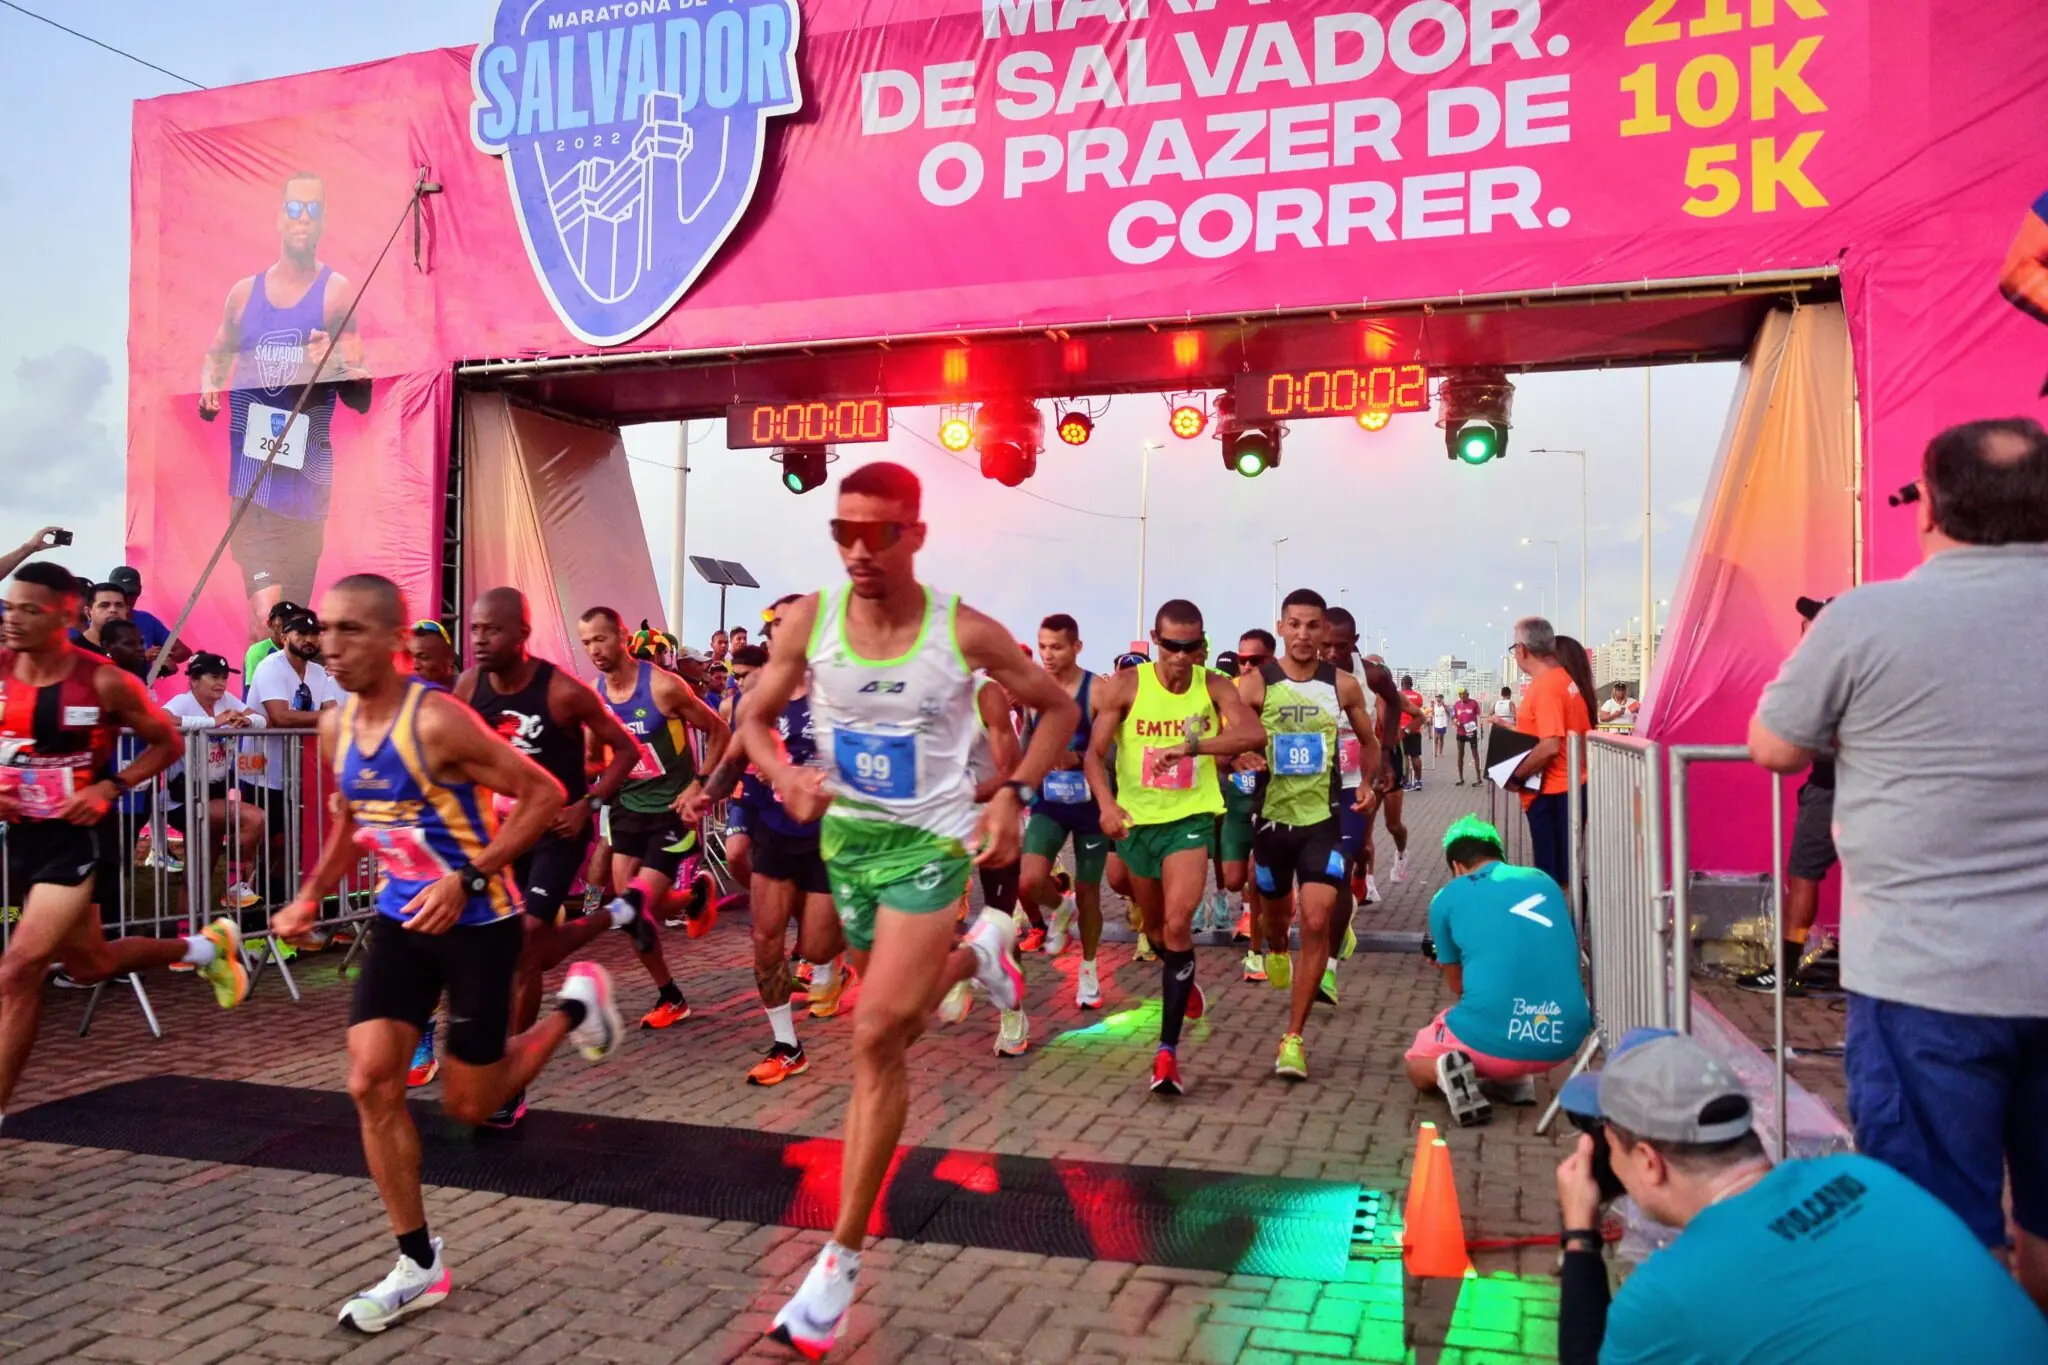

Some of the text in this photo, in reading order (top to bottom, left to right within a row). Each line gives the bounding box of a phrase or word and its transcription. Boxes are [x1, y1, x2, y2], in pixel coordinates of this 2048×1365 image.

[549, 0, 671, 29] MARATONA
[482, 3, 787, 140] SALVADOR
[862, 62, 976, 136] DE
[997, 0, 1569, 120] SALVADOR.
[1620, 36, 1828, 137] 10K
[556, 132, 620, 152] 2022
[919, 76, 1569, 206] O PRAZER DE
[1682, 131, 1829, 218] 5K
[1108, 167, 1570, 264] CORRER.
[255, 344, 304, 364] SALVADOR
[1267, 365, 1424, 415] 0:00:02
[752, 401, 882, 443] 0:00:00
[856, 752, 890, 780] 99
[1290, 747, 1309, 764] 98
[1241, 775, 1255, 788] 96
[1513, 998, 1562, 1016] Bendito
[1507, 1018, 1564, 1044] PACE
